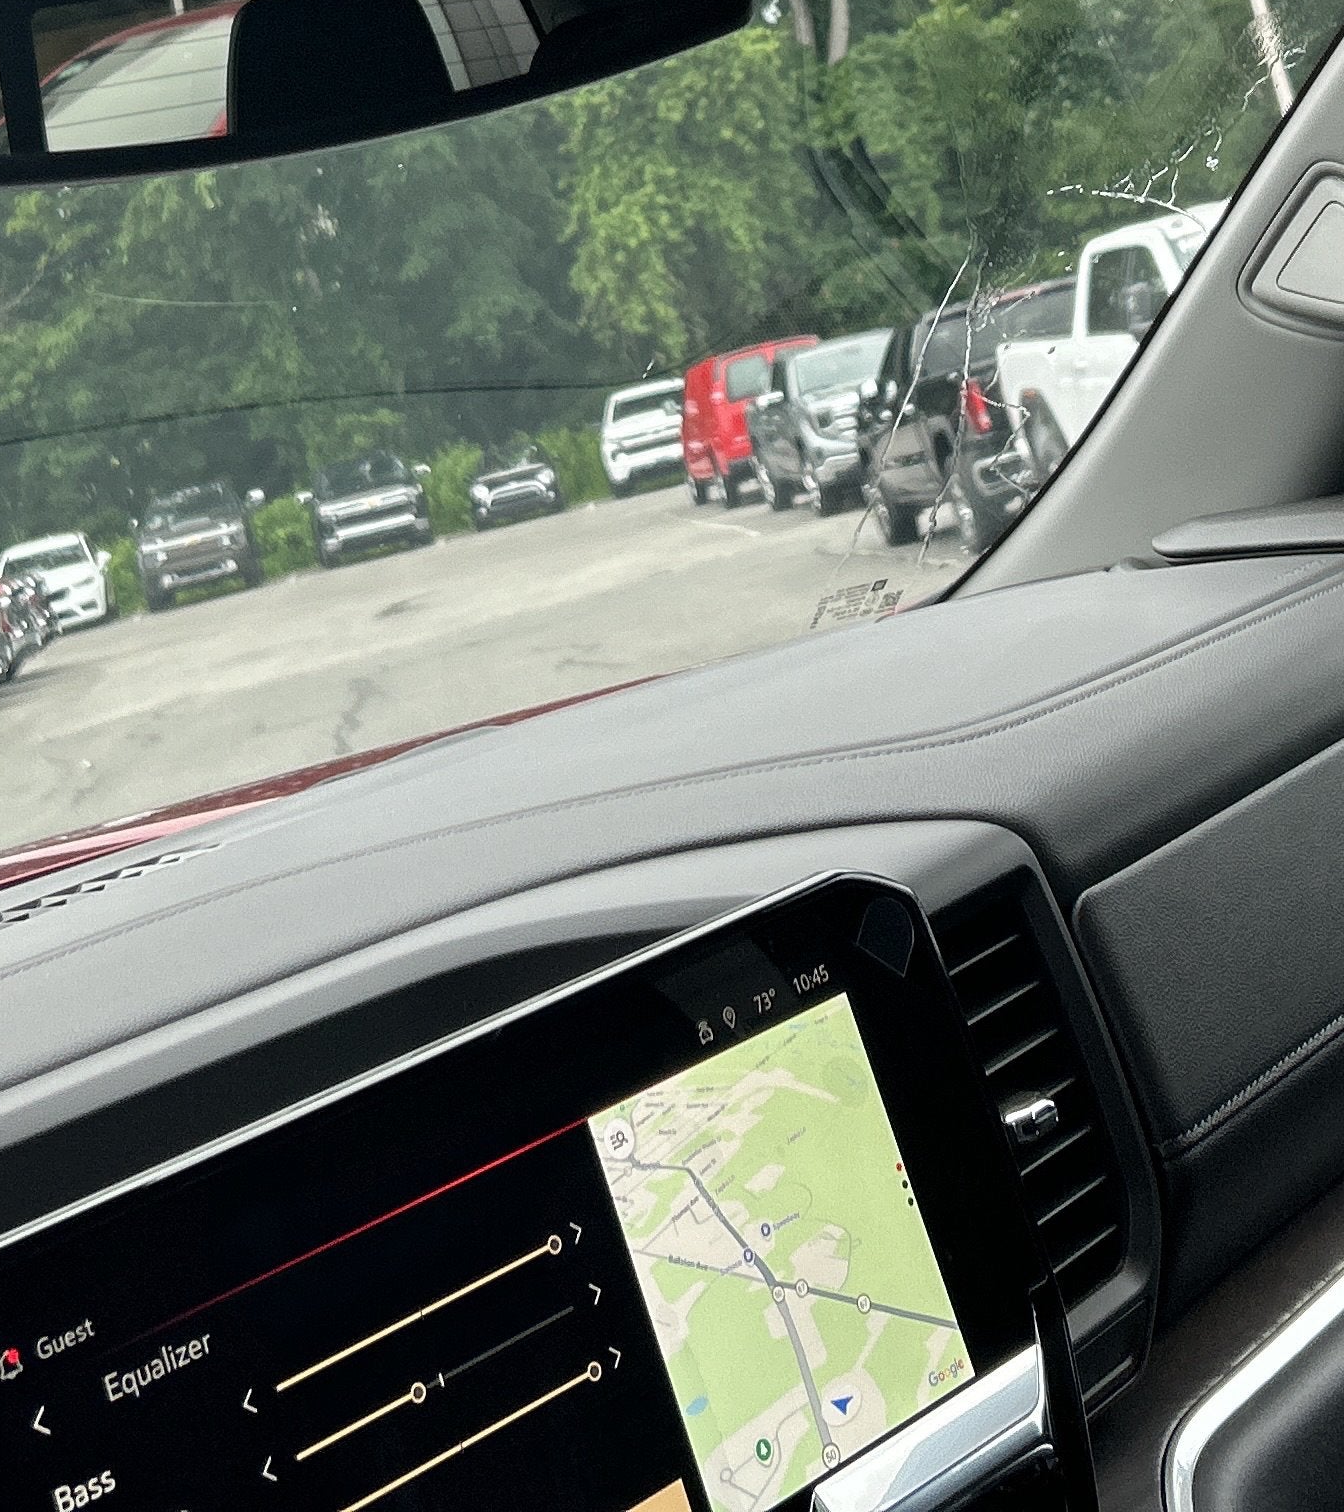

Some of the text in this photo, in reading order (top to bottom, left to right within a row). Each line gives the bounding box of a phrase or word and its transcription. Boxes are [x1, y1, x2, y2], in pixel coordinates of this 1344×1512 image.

[793, 964, 829, 994] 10:45
[36, 1318, 96, 1360] Guest
[104, 1334, 211, 1401] Equalizer
[928, 1358, 965, 1387] Google
[53, 1470, 117, 1512] Bass
